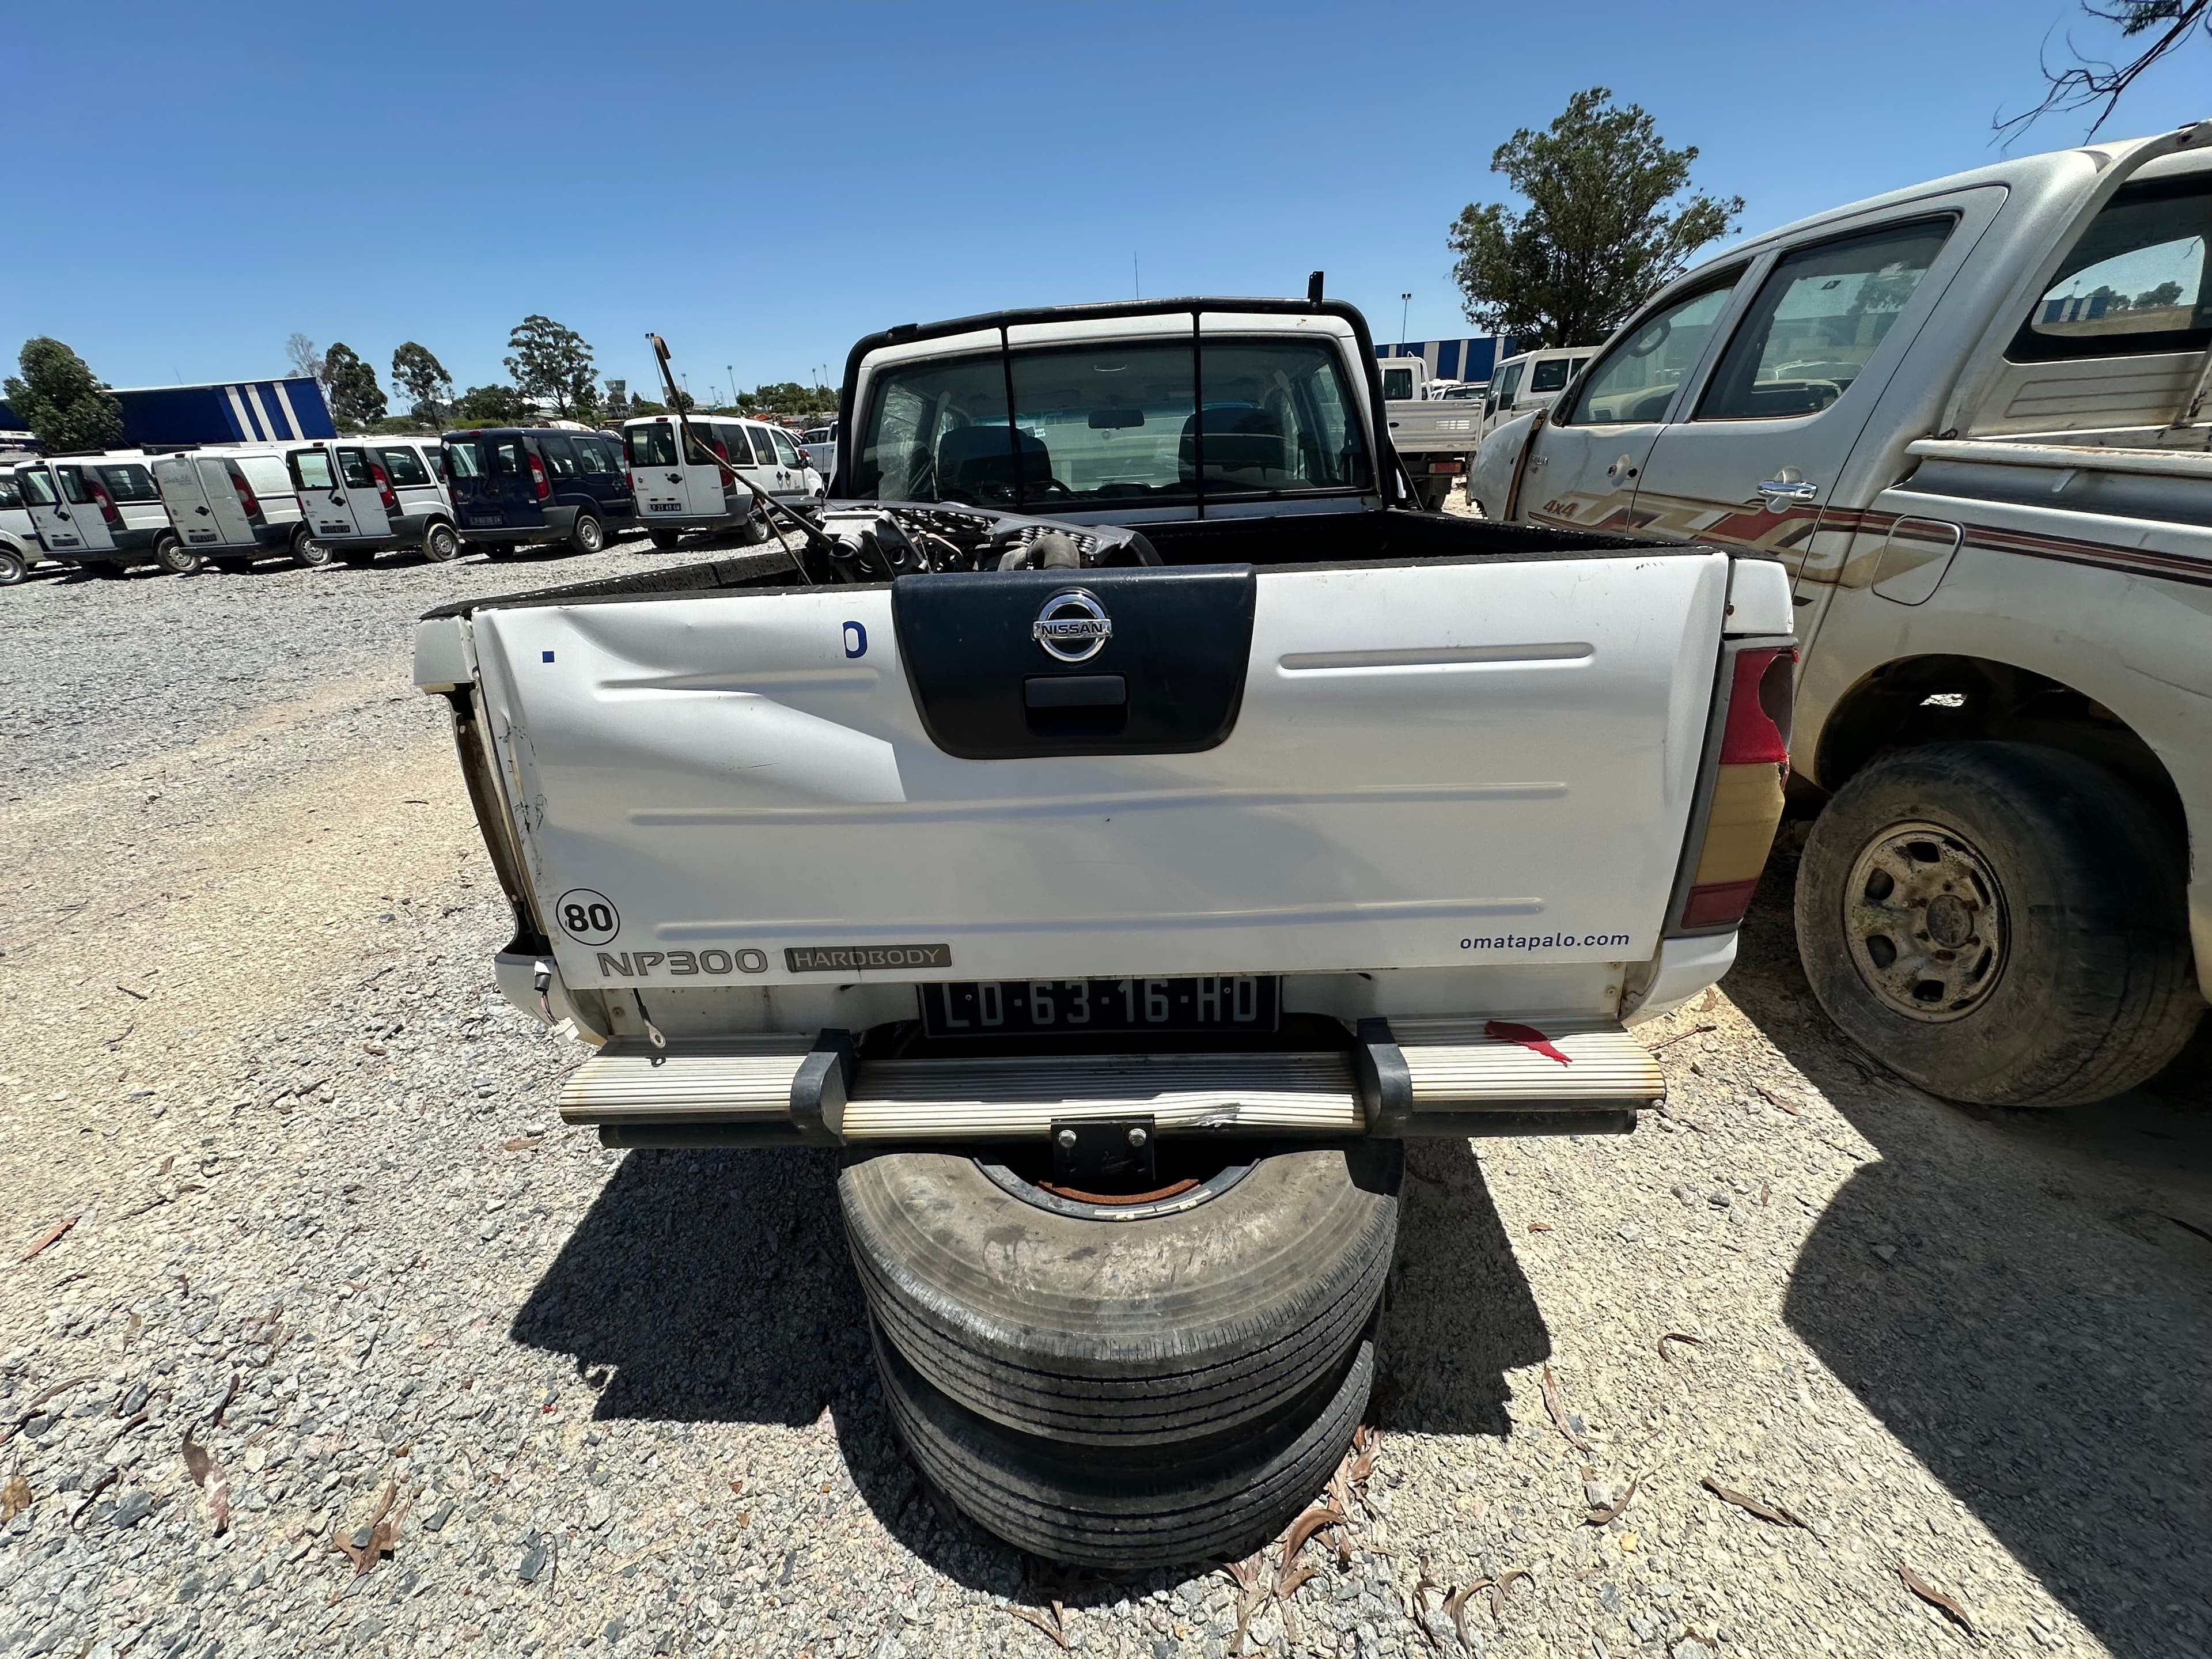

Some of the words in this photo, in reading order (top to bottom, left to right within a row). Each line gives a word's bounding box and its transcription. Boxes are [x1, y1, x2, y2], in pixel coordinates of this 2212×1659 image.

[1041, 623, 1103, 635] NISSAN
[564, 903, 613, 932] 80
[1460, 933, 1630, 951] omatapalo.com
[596, 949, 768, 977] NP300
[794, 949, 940, 968] HARDBODY
